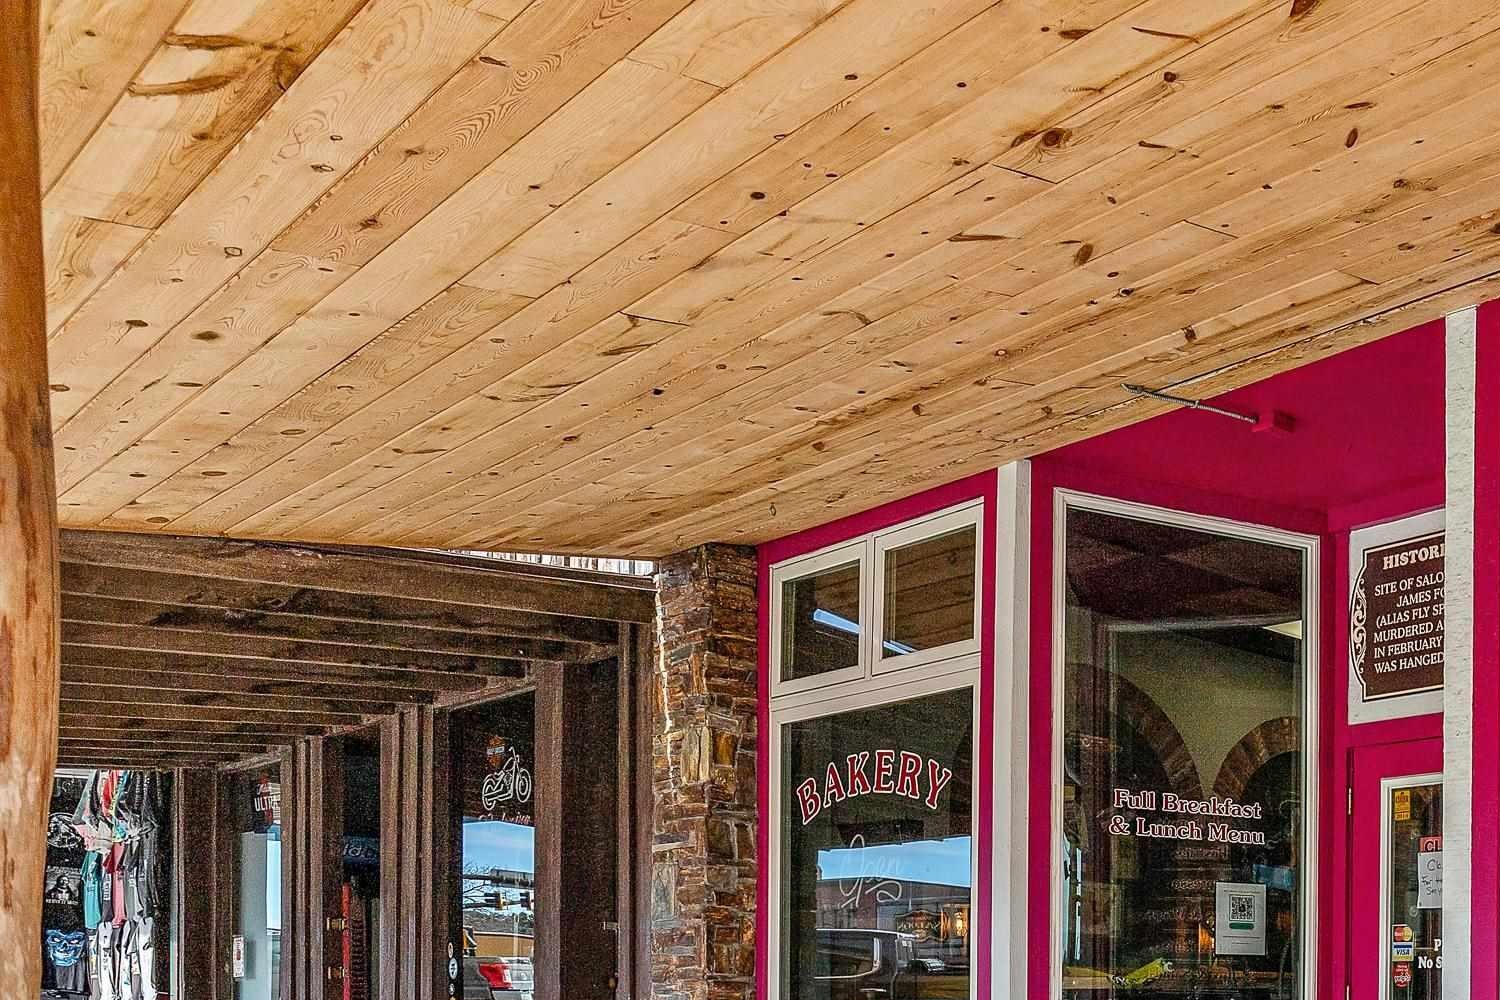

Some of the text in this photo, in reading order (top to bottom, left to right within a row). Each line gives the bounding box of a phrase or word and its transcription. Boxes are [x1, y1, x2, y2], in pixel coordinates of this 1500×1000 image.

[1374, 571, 1444, 597] SITE OF SALO
[1396, 590, 1431, 607] JAMES
[1376, 610, 1410, 629] (ALIAS
[1412, 606, 1430, 620] FLY
[1373, 622, 1434, 643] MURDERED
[1374, 635, 1443, 659] IN FEBRUARY
[1374, 651, 1444, 674] WAS HANGED
[796, 749, 952, 826] BAKERY
[1113, 788, 1263, 820] Full Breakfast
[1109, 815, 1266, 845] & Lunch Menu
[1418, 956, 1433, 969] No
